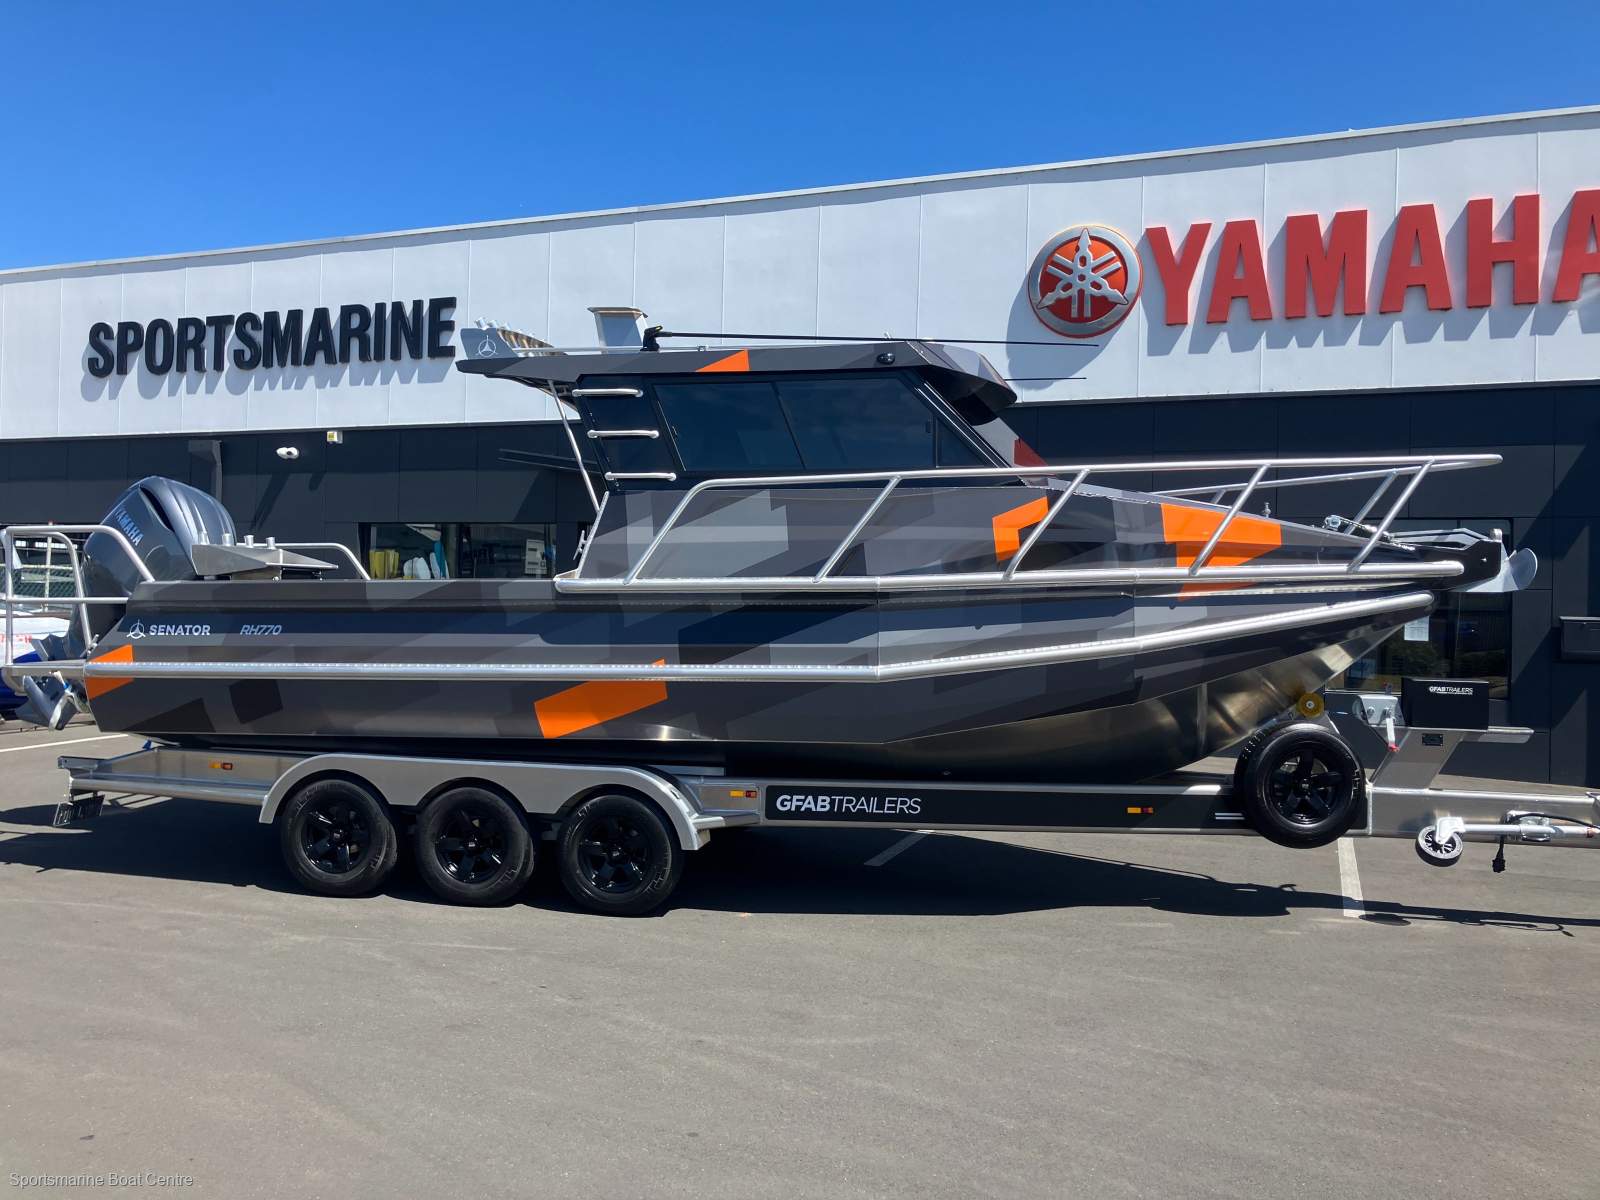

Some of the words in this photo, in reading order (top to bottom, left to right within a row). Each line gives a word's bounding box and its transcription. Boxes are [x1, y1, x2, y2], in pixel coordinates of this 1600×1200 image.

[1145, 189, 1600, 326] YAMAHA
[87, 297, 457, 378] SPORTSMARINE
[149, 624, 211, 636] SENATOR
[239, 624, 282, 636] RH770
